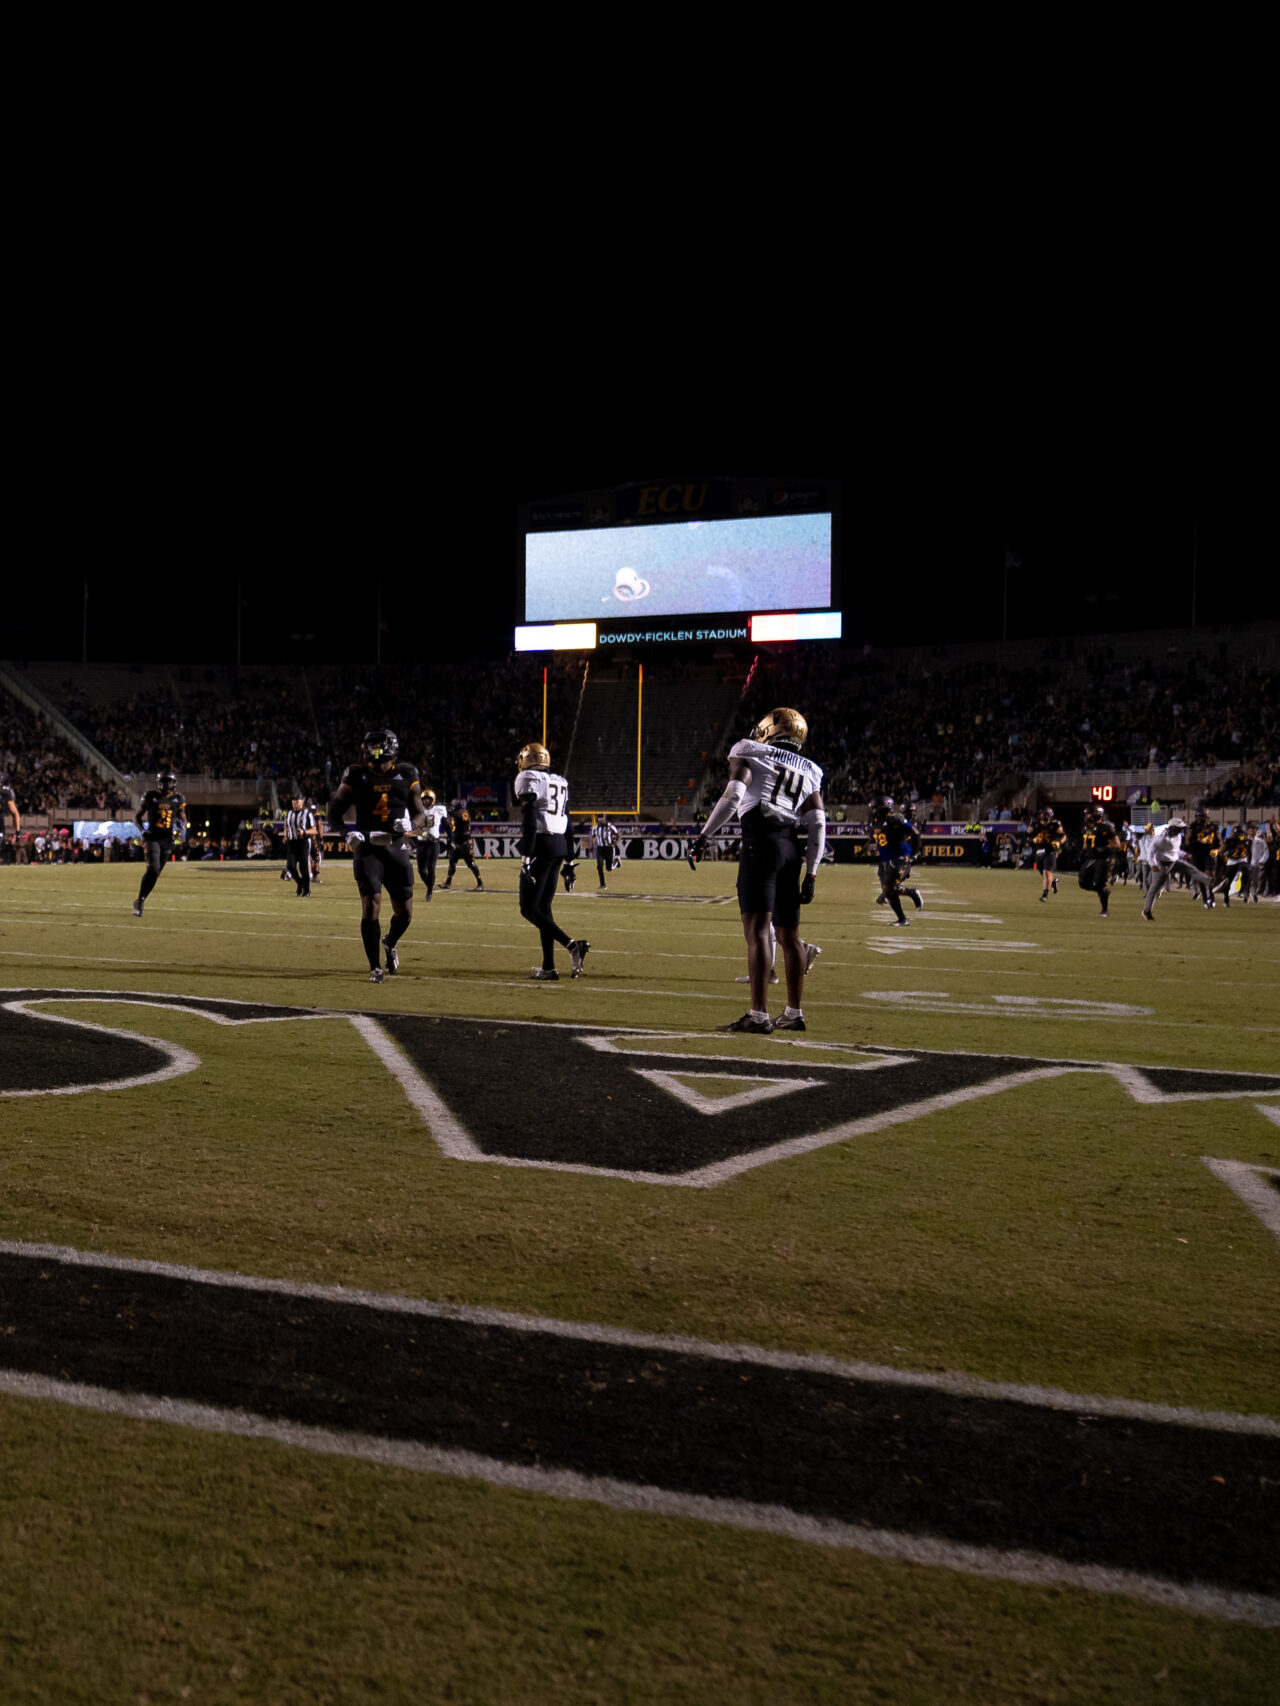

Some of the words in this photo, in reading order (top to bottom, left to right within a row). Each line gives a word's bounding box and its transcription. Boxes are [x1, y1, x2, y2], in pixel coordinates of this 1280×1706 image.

[636, 483, 710, 515] ECU
[599, 630, 693, 645] DOWDY-FICKLEN
[696, 628, 747, 641] STADIUM
[546, 784, 567, 817] 37
[1092, 785, 1113, 801] 40
[372, 793, 391, 823] 4
[924, 845, 965, 857] FIELD
